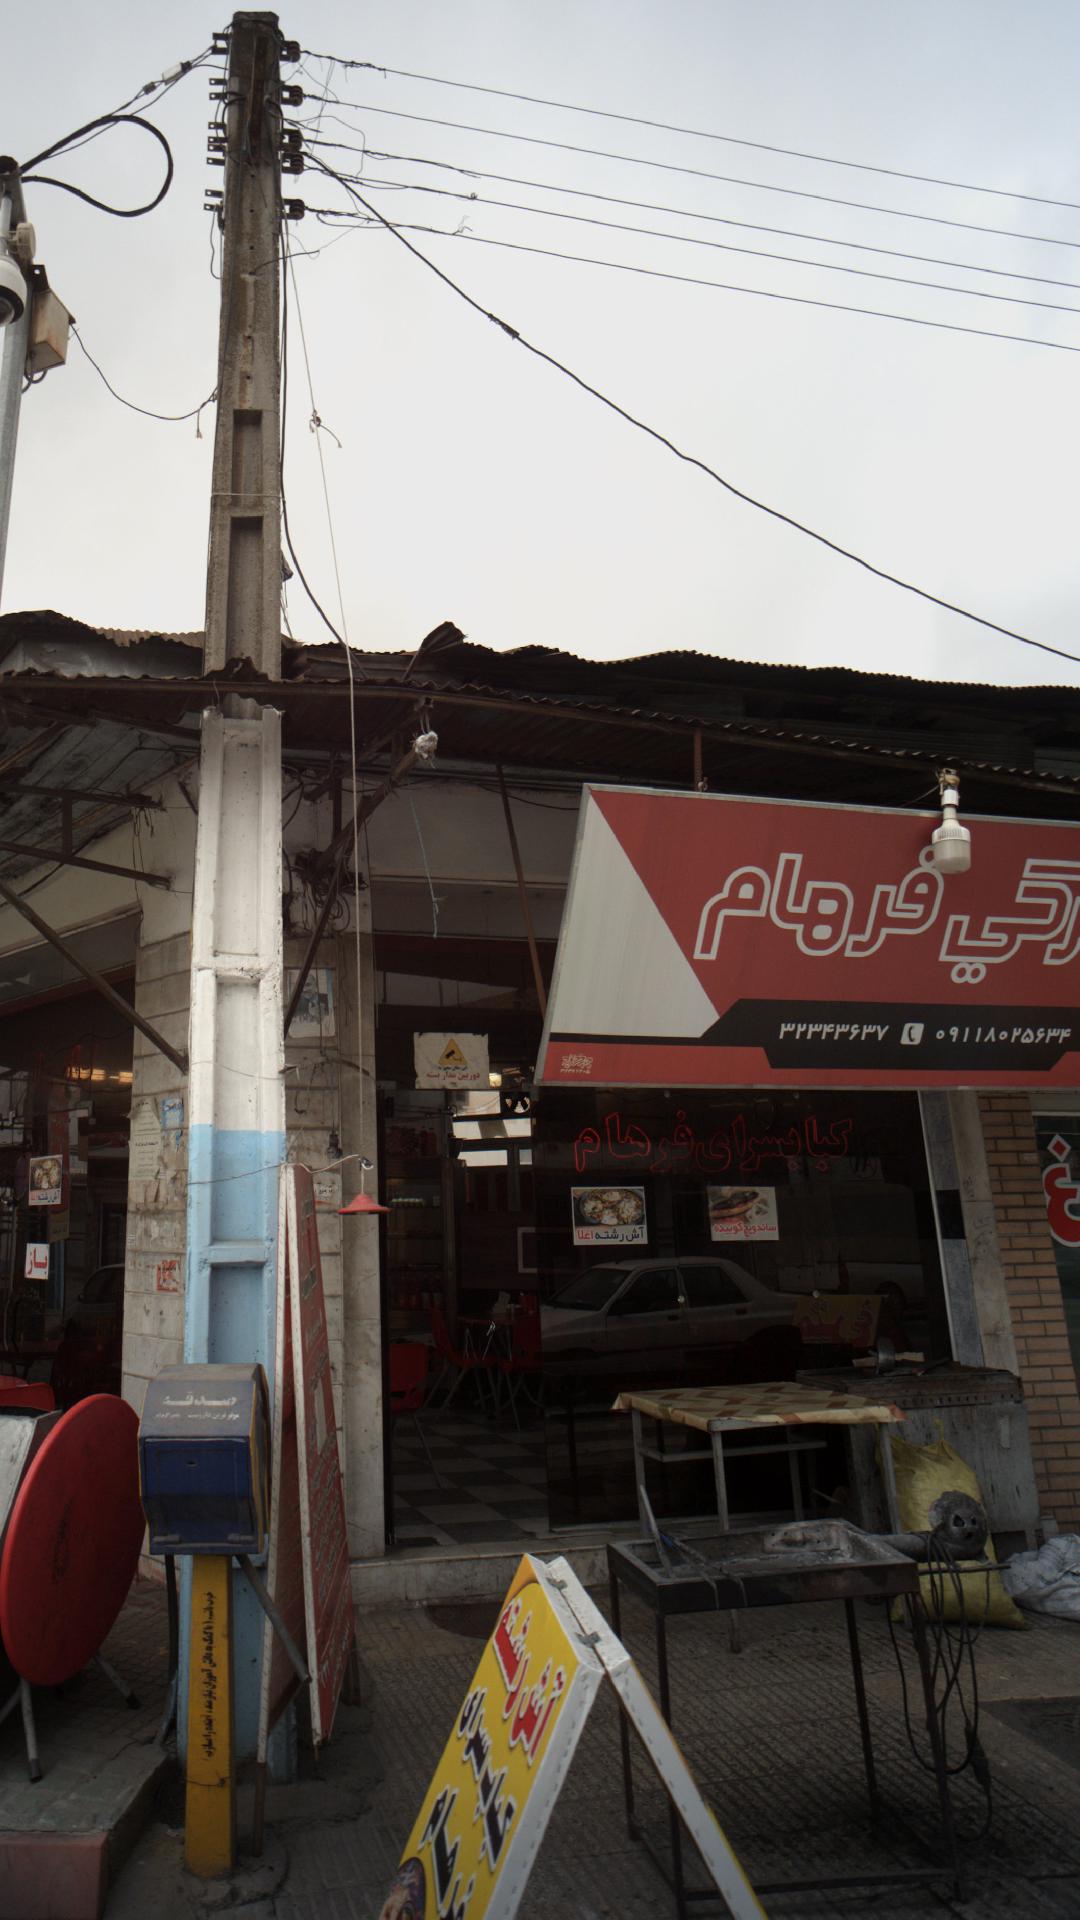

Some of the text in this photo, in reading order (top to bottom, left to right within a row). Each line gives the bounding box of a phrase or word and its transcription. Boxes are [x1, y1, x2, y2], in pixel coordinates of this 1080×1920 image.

[693, 845, 945, 960] فرهام
[779, 1022, 1072, 1045] ۳۲۳۴۳۶۳۷ ۰۹۱۱۸۰۲۵۶۳۴
[457, 1071, 481, 1081] دوربین
[573, 1109, 696, 1173] فرهام
[577, 1226, 644, 1241] آش رشته اعلا
[714, 1221, 777, 1237] ساندویچ کوبیده
[27, 1247, 48, 1274] باز
[493, 1597, 567, 1768] آش رشته
